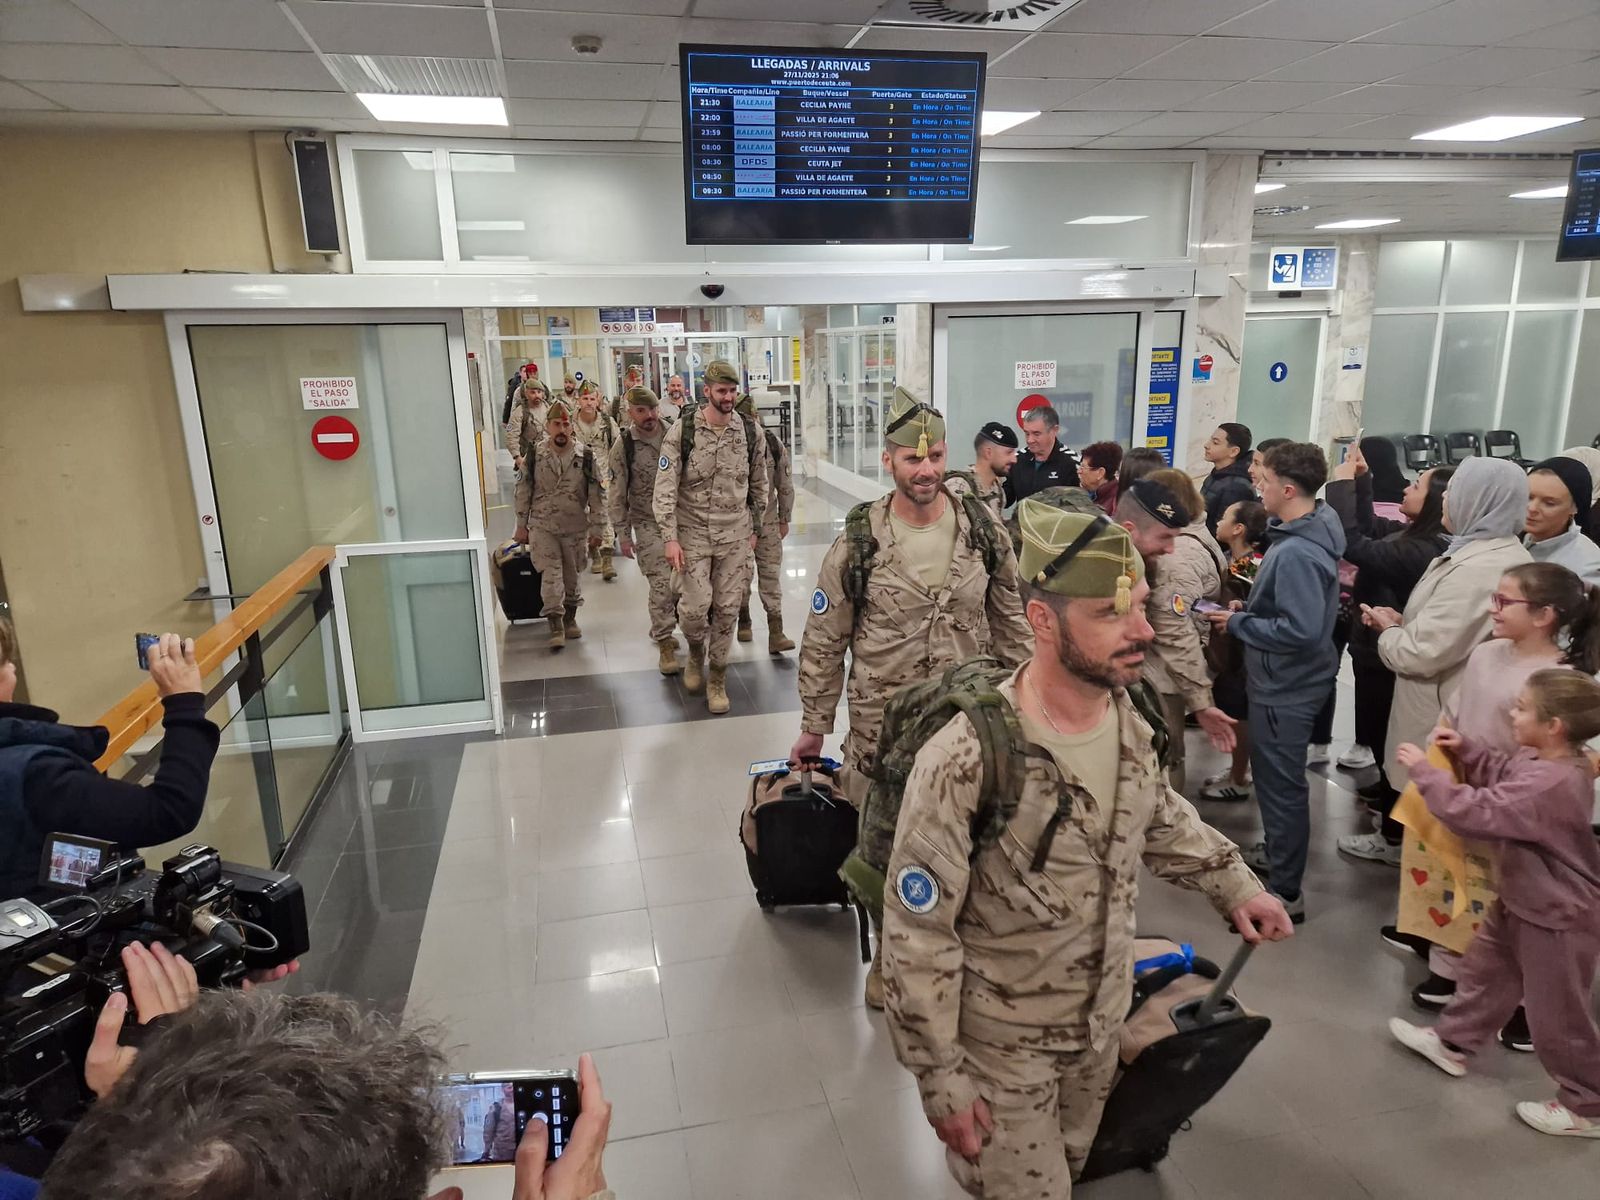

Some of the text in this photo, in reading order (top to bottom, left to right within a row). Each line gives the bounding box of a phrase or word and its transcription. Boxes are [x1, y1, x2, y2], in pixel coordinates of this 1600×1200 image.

[751, 58, 871, 71] LLEGADAS / ARRIVALS
[783, 71, 820, 79] 27/11/2025
[771, 79, 852, 87] www.puertodeceuta.com
[691, 87, 728, 95] Hora/Time
[802, 89, 849, 97] Buque/Vessel
[823, 131, 869, 139] FORMENTERA
[741, 158, 768, 166] DFDS
[1017, 362, 1055, 370] PROHIBIDO
[1031, 370, 1051, 378] PASO
[303, 379, 354, 388] PROHIBIDO
[1019, 379, 1050, 387] "SALIDA"
[311, 388, 349, 397] EL PASO
[309, 398, 350, 407] "SALIDA"
